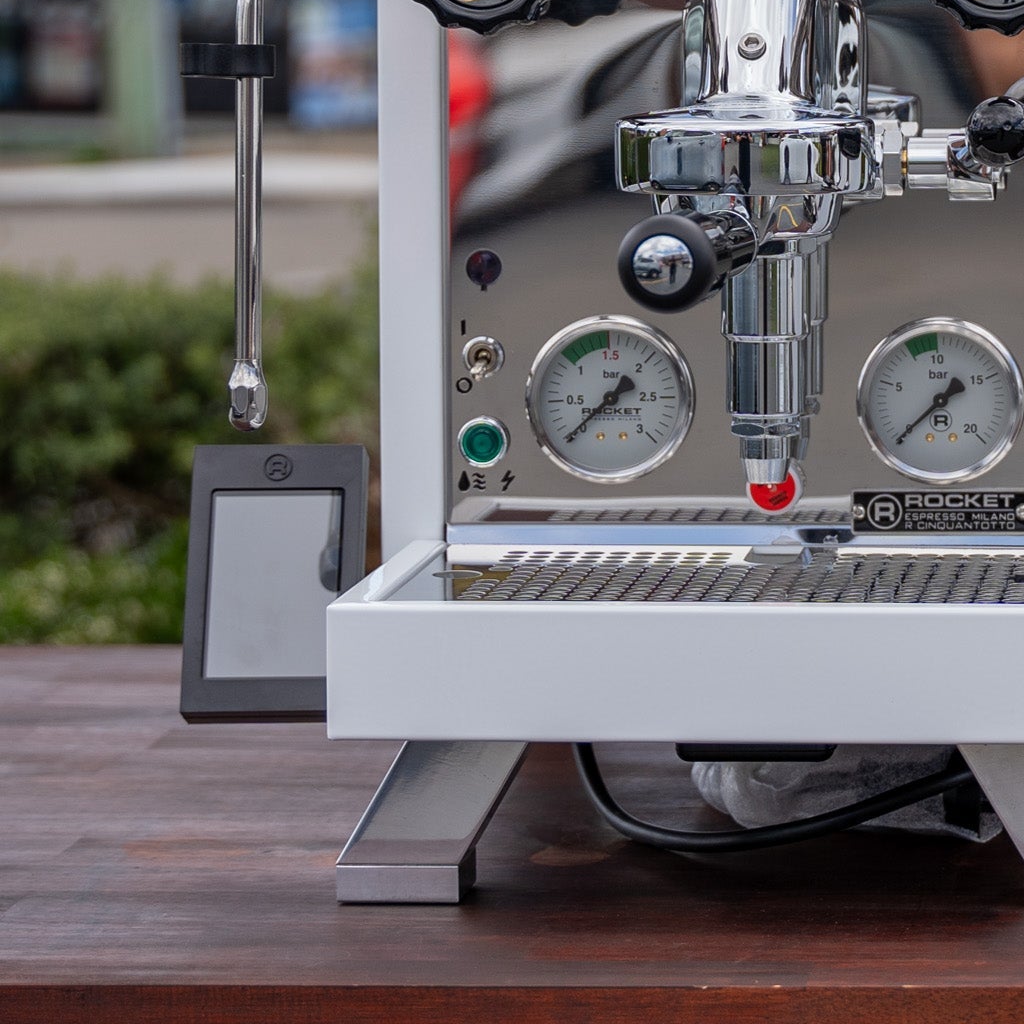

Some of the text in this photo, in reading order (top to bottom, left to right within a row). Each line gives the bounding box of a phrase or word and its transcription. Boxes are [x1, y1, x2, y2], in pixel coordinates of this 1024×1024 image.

[602, 351, 620, 361] 1.5
[931, 355, 944, 364] 10
[577, 365, 583, 375] 1
[635, 363, 643, 373] 2
[603, 369, 619, 379] bar
[928, 369, 948, 379] bar
[969, 375, 983, 385] 15
[895, 381, 903, 392] 5
[566, 395, 584, 405] 0.5
[639, 392, 657, 402] 2.5
[636, 423, 644, 434] 3
[963, 423, 978, 434] 20
[904, 493, 1015, 508] ROCKET
[904, 512, 1015, 521] ESPRESSO MILANO
[904, 522, 1016, 531] R CINQUANTOTTO
